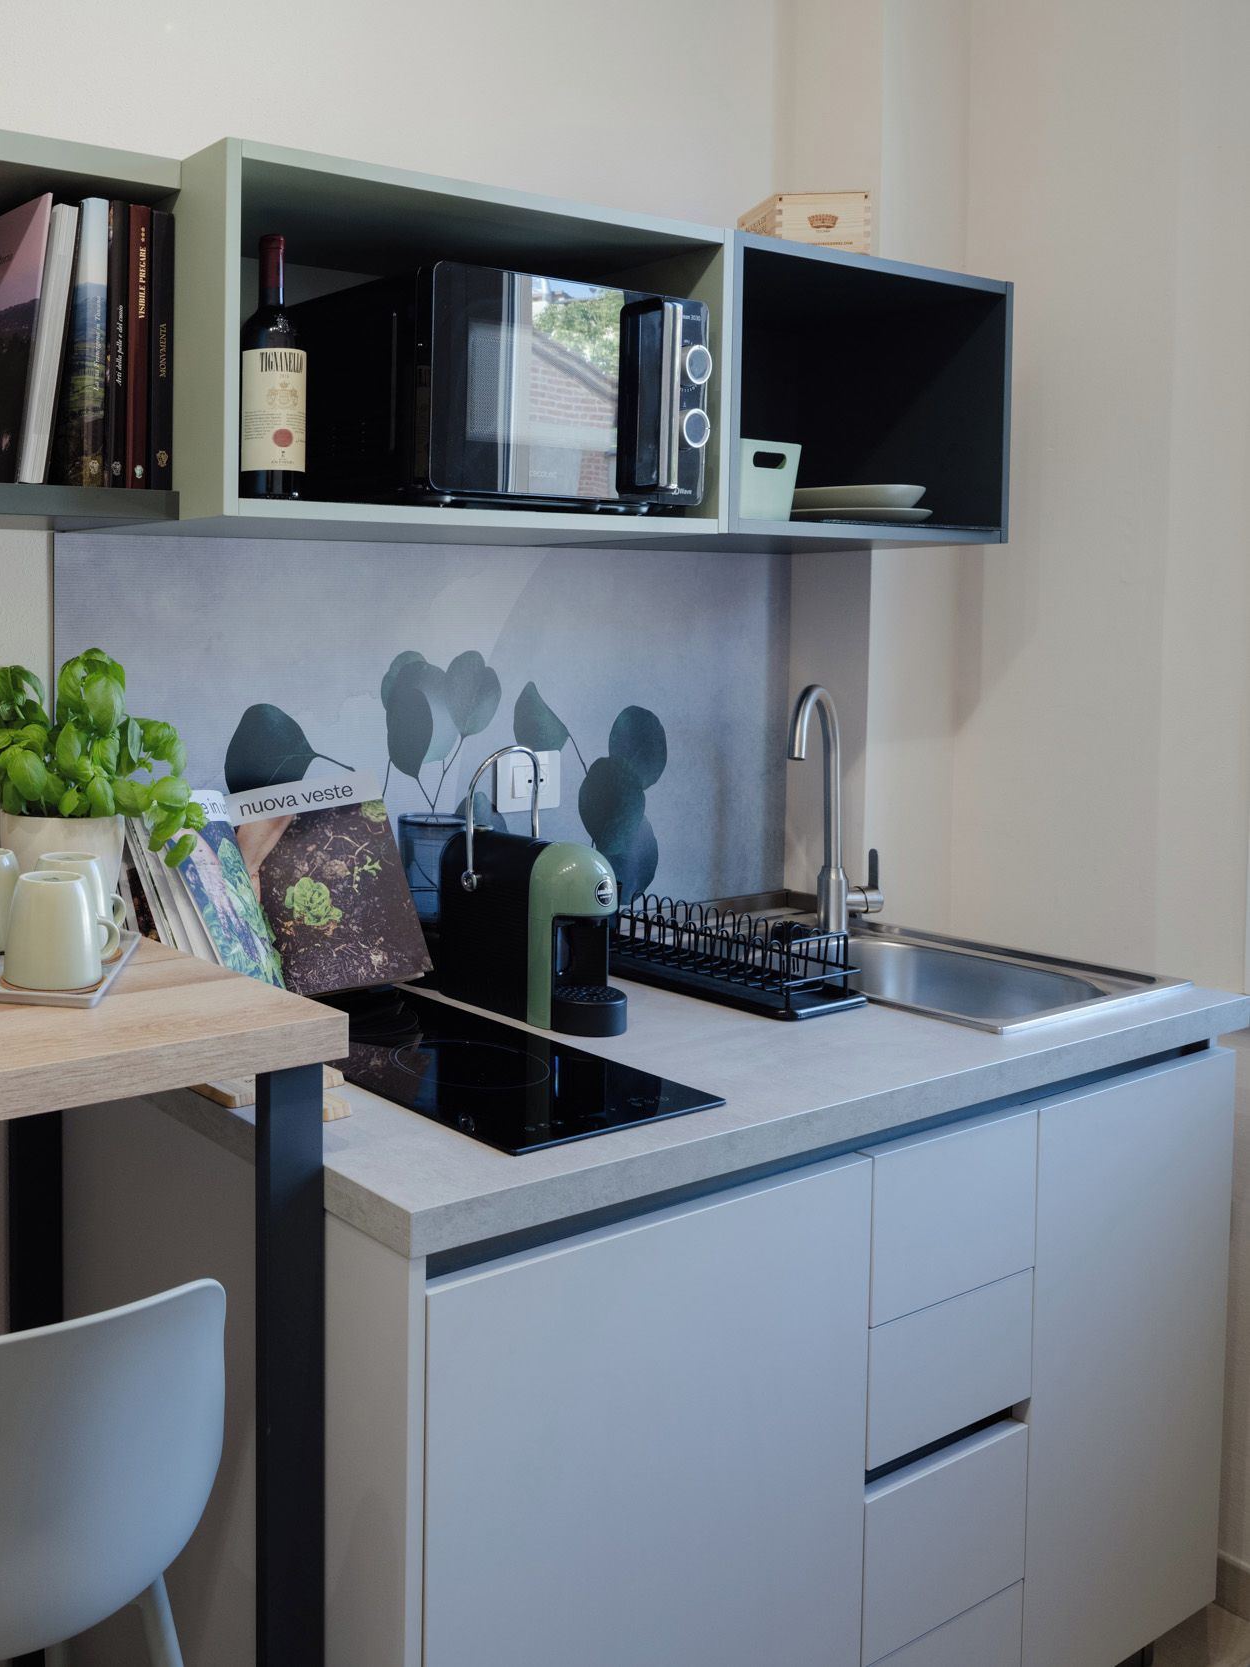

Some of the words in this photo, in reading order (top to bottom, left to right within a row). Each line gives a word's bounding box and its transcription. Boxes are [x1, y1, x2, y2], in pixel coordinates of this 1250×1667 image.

[139, 246, 147, 284] PREGARE
[138, 284, 146, 319] VISIBILE
[116, 339, 124, 355] pelle
[159, 323, 167, 378] MONVMENTA
[259, 351, 305, 374] TIGNANELLO
[239, 794, 299, 817] nuova
[301, 784, 354, 803] veste
